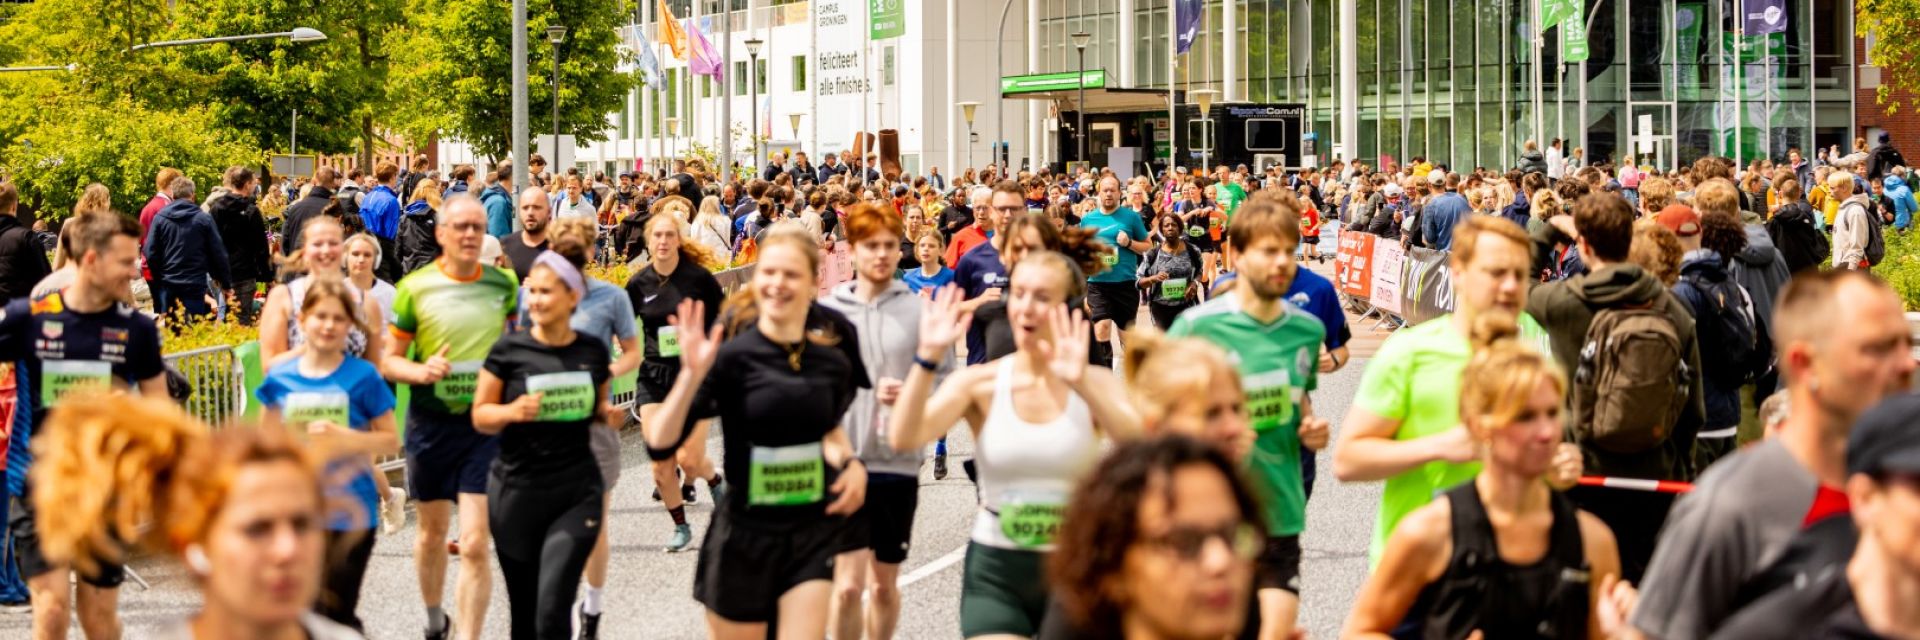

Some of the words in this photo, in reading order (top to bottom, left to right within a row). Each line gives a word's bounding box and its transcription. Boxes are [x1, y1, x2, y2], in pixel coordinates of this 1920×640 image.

[819, 50, 858, 70] feliciteert
[819, 77, 834, 96] alle
[835, 75, 873, 95] finishes.
[443, 372, 477, 382] ANTO
[545, 385, 588, 397] WENDY
